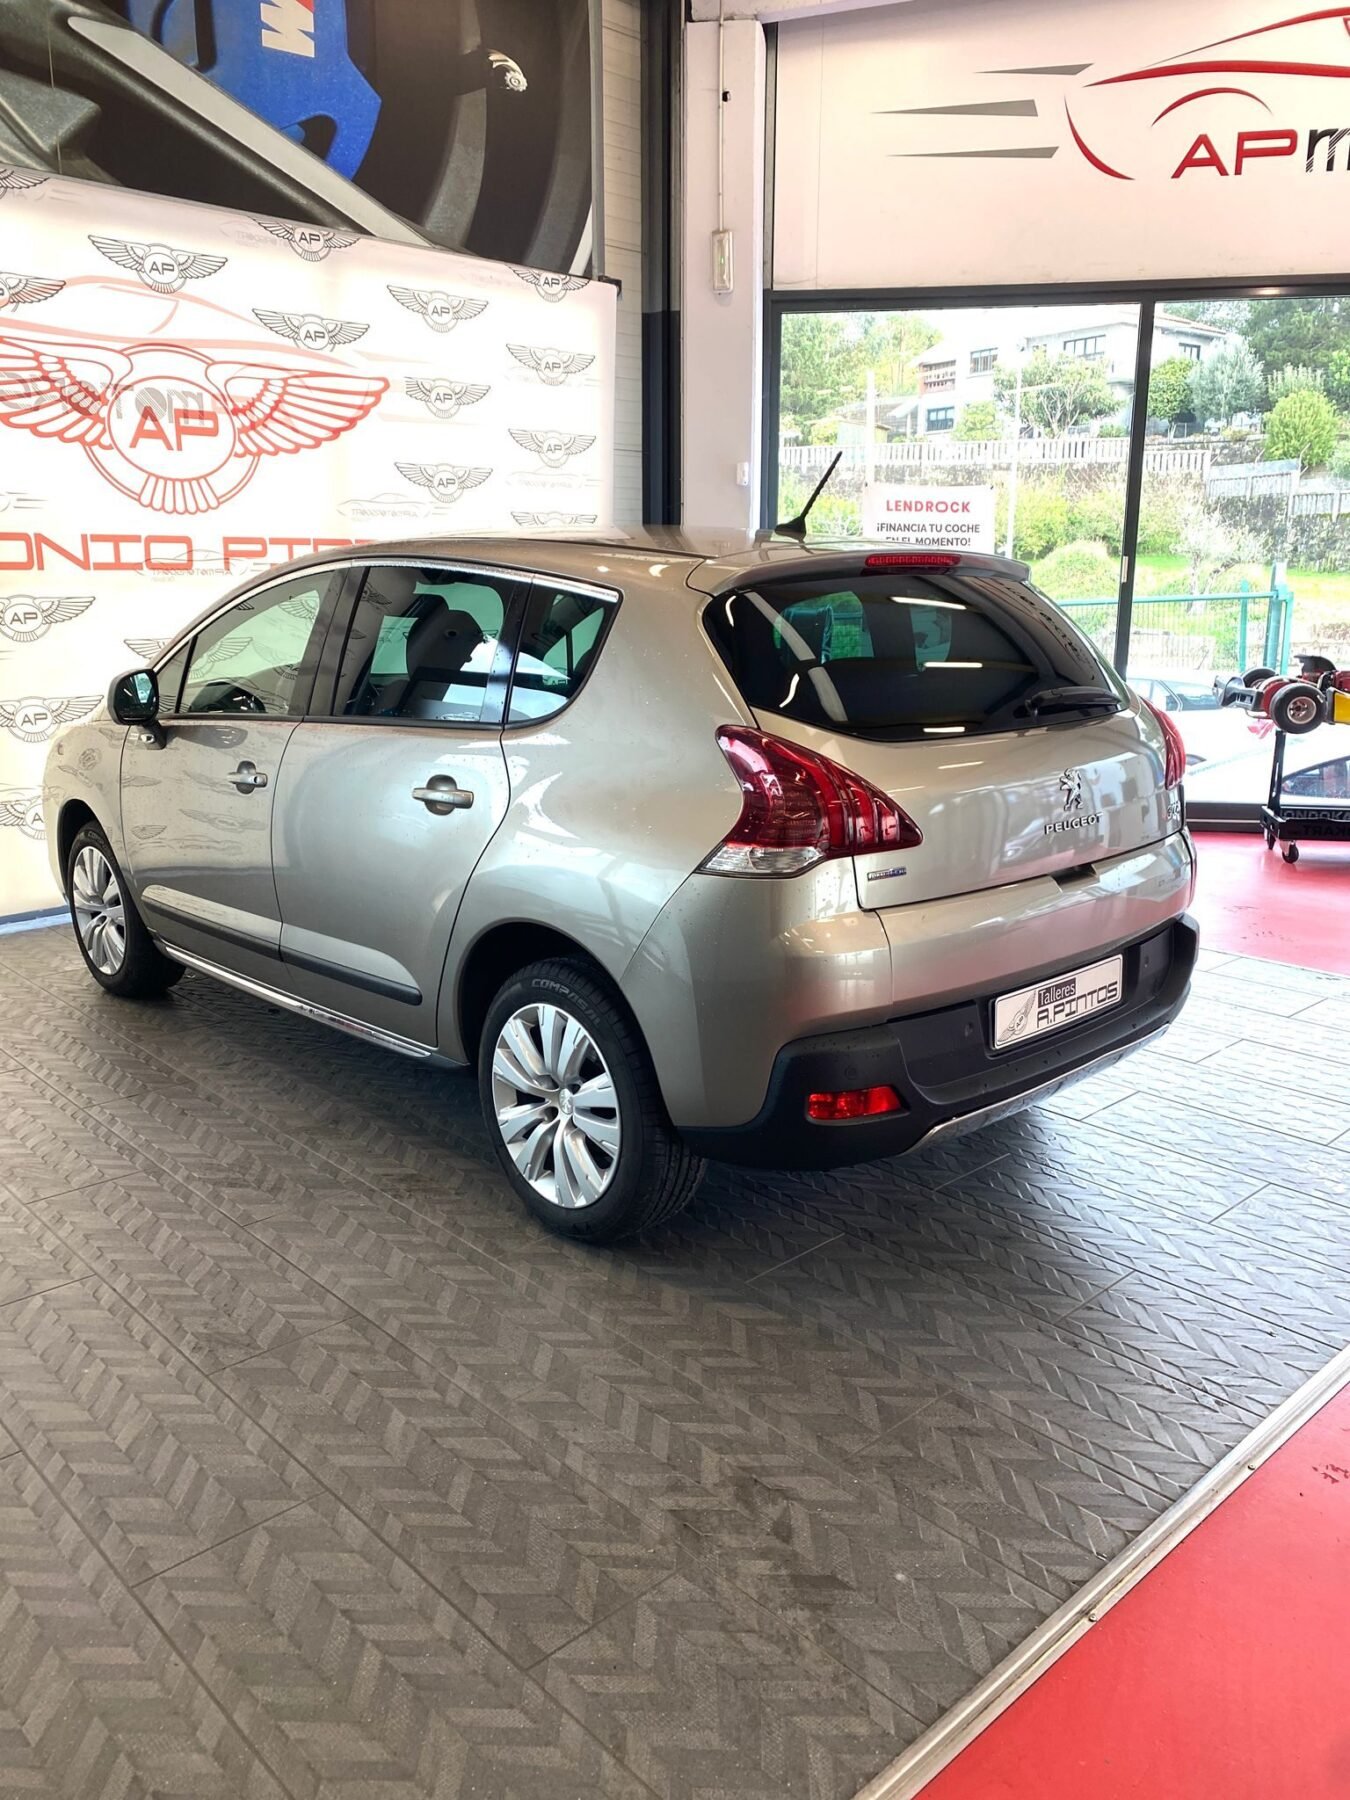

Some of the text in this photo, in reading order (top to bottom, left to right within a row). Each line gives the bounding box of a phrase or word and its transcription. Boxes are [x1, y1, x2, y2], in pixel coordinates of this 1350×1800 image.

[298, 232, 321, 246] AP
[149, 261, 175, 276] AP
[543, 276, 561, 288] AP
[431, 305, 451, 317] AP
[303, 329, 326, 343] AP
[543, 360, 562, 372] AP
[433, 392, 453, 404] AP
[129, 405, 219, 452] AP
[545, 443, 563, 454] AP
[436, 477, 457, 489] AP
[886, 500, 971, 513] LENDROCK
[876, 522, 980, 534] ¡FINANCIA TU COCHE
[915, 537, 971, 547] MOMENTO!
[9, 611, 38, 625] AP
[20, 712, 48, 727] AP
[1044, 812, 1103, 835] PEUGEOT
[1040, 983, 1076, 1006] Talleres
